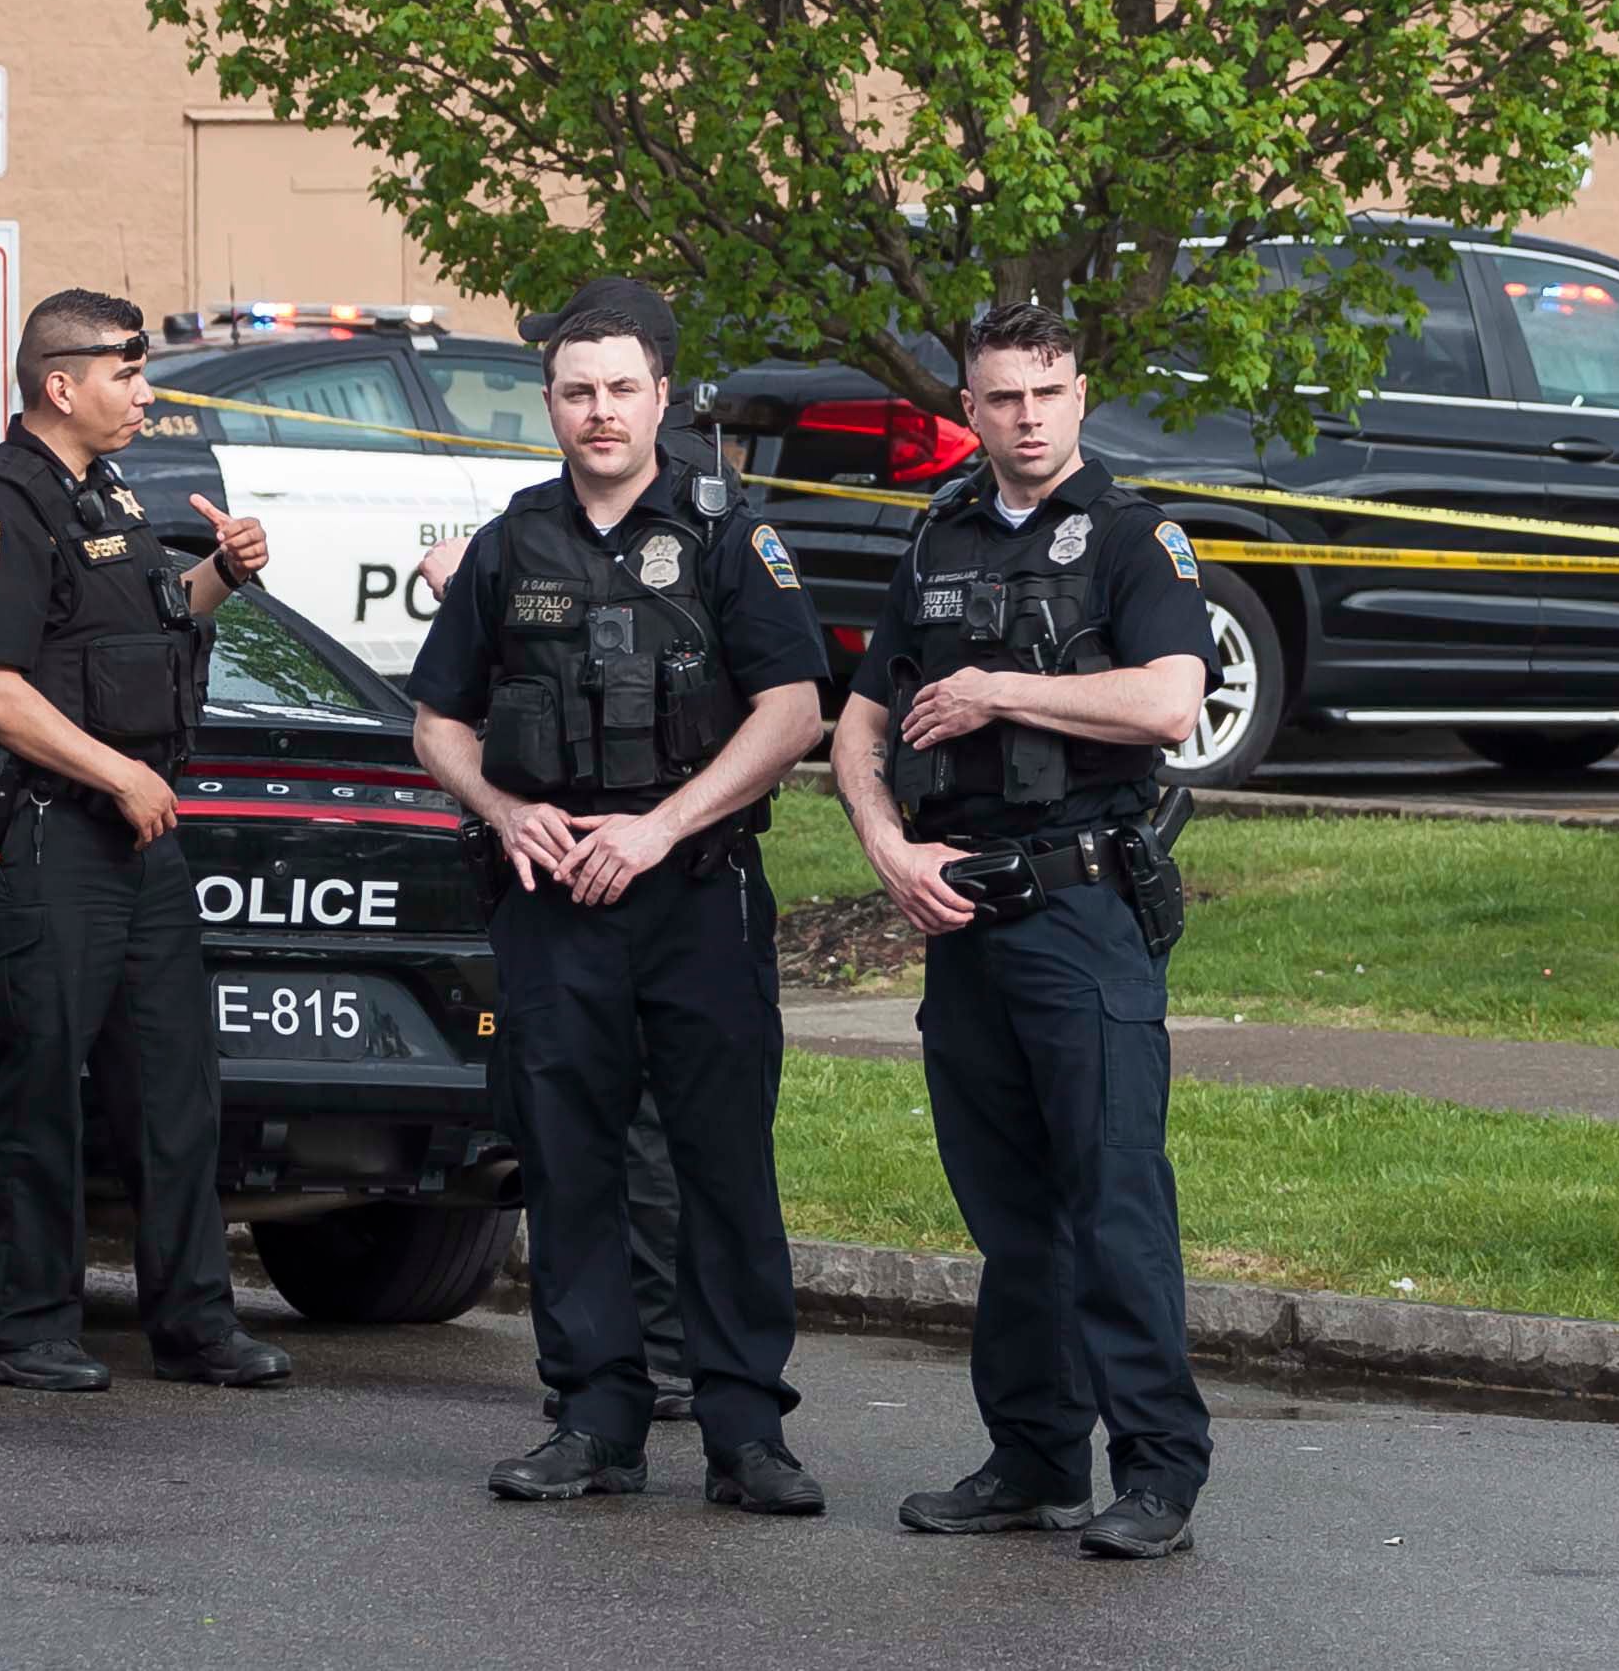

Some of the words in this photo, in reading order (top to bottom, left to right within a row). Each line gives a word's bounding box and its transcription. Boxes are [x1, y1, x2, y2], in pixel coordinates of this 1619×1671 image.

[83, 534, 128, 560] SHERIFF
[514, 594, 573, 610] BUFFALO
[922, 589, 964, 606] BUFFAL
[517, 608, 564, 623] POLICE
[922, 603, 964, 619] POLICE
[197, 781, 415, 803] ODGE
[195, 875, 400, 926] OLICE
[218, 984, 360, 1039] E-815
